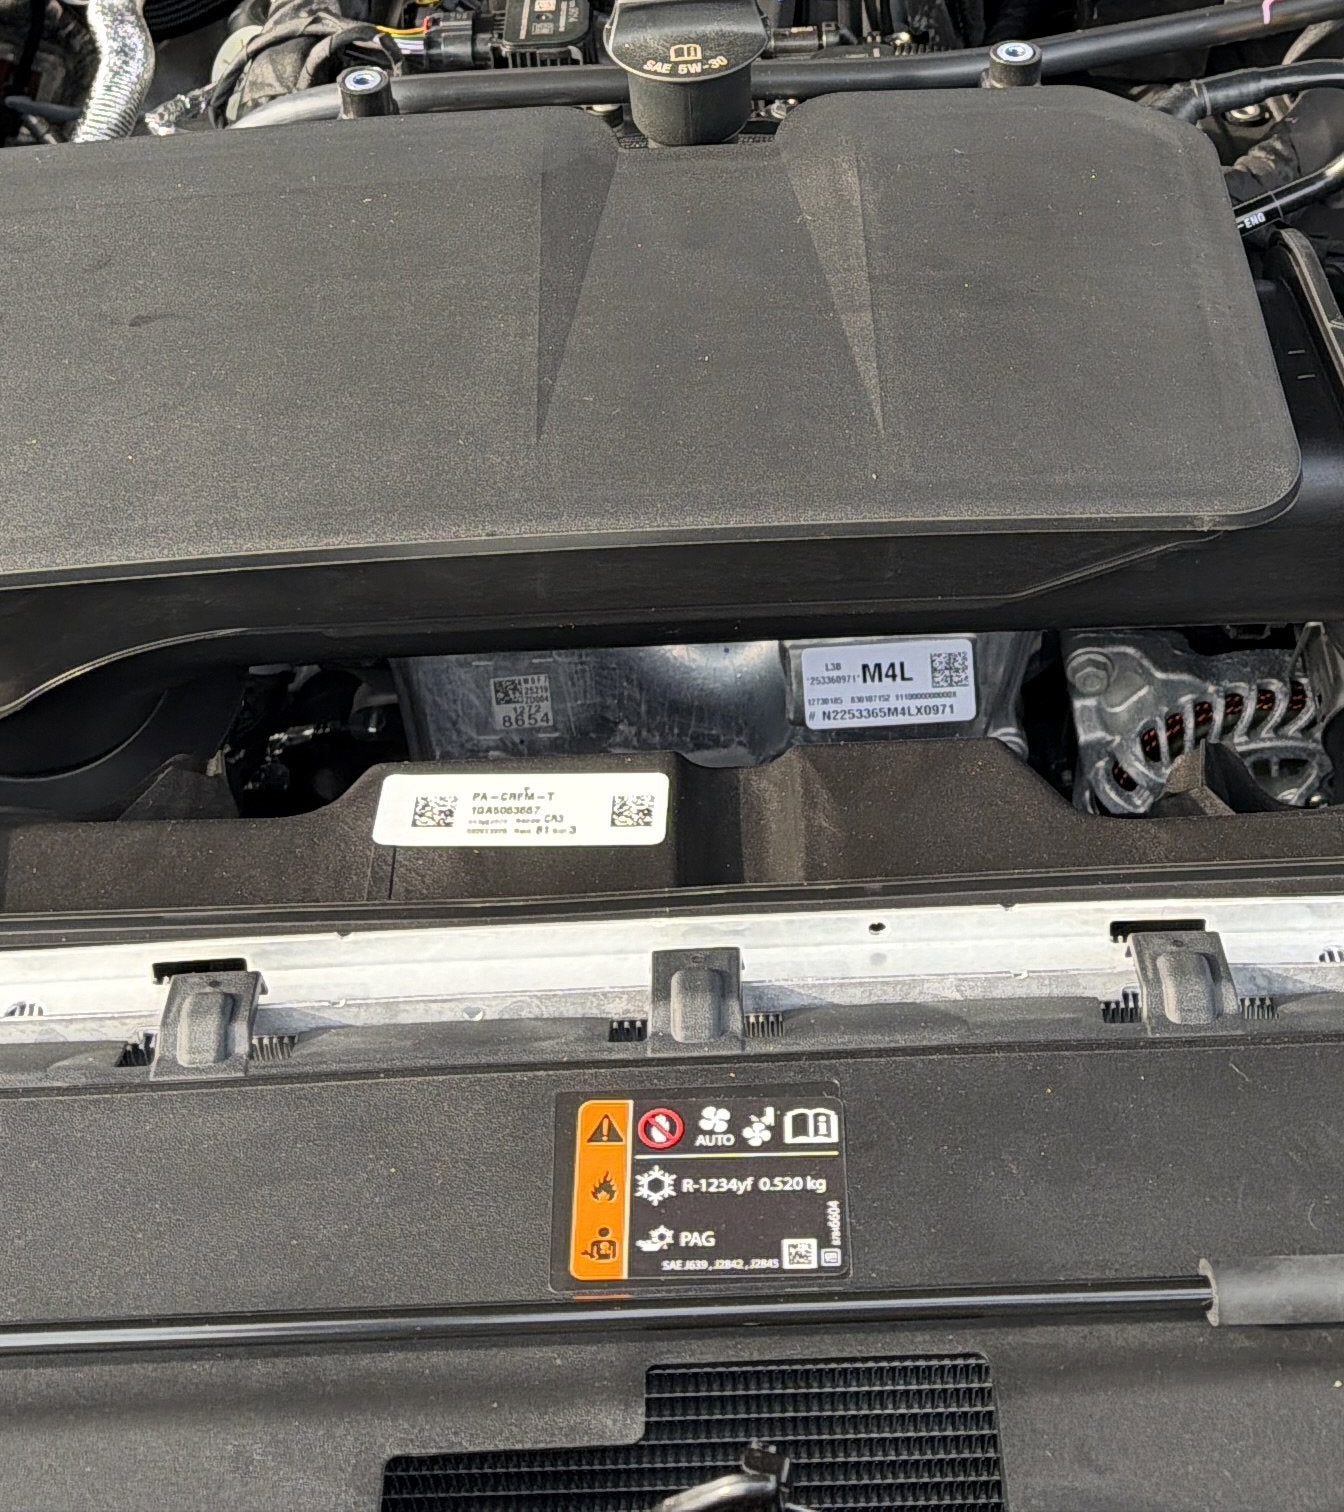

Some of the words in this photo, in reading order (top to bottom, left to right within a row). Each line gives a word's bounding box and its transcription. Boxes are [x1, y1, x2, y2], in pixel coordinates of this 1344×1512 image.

[643, 59, 672, 74] SAE
[678, 55, 729, 74] 5W-30
[861, 661, 913, 684] M4L
[502, 711, 550, 728] 8654
[822, 703, 955, 721] N2253365M4LX0971
[694, 1134, 735, 1147] AUTO
[681, 1176, 755, 1195] R-1234yf
[758, 1176, 804, 1191] 0.520
[806, 1175, 827, 1193] kg
[679, 1231, 716, 1247] PAG
[661, 1259, 684, 1271] SAE
